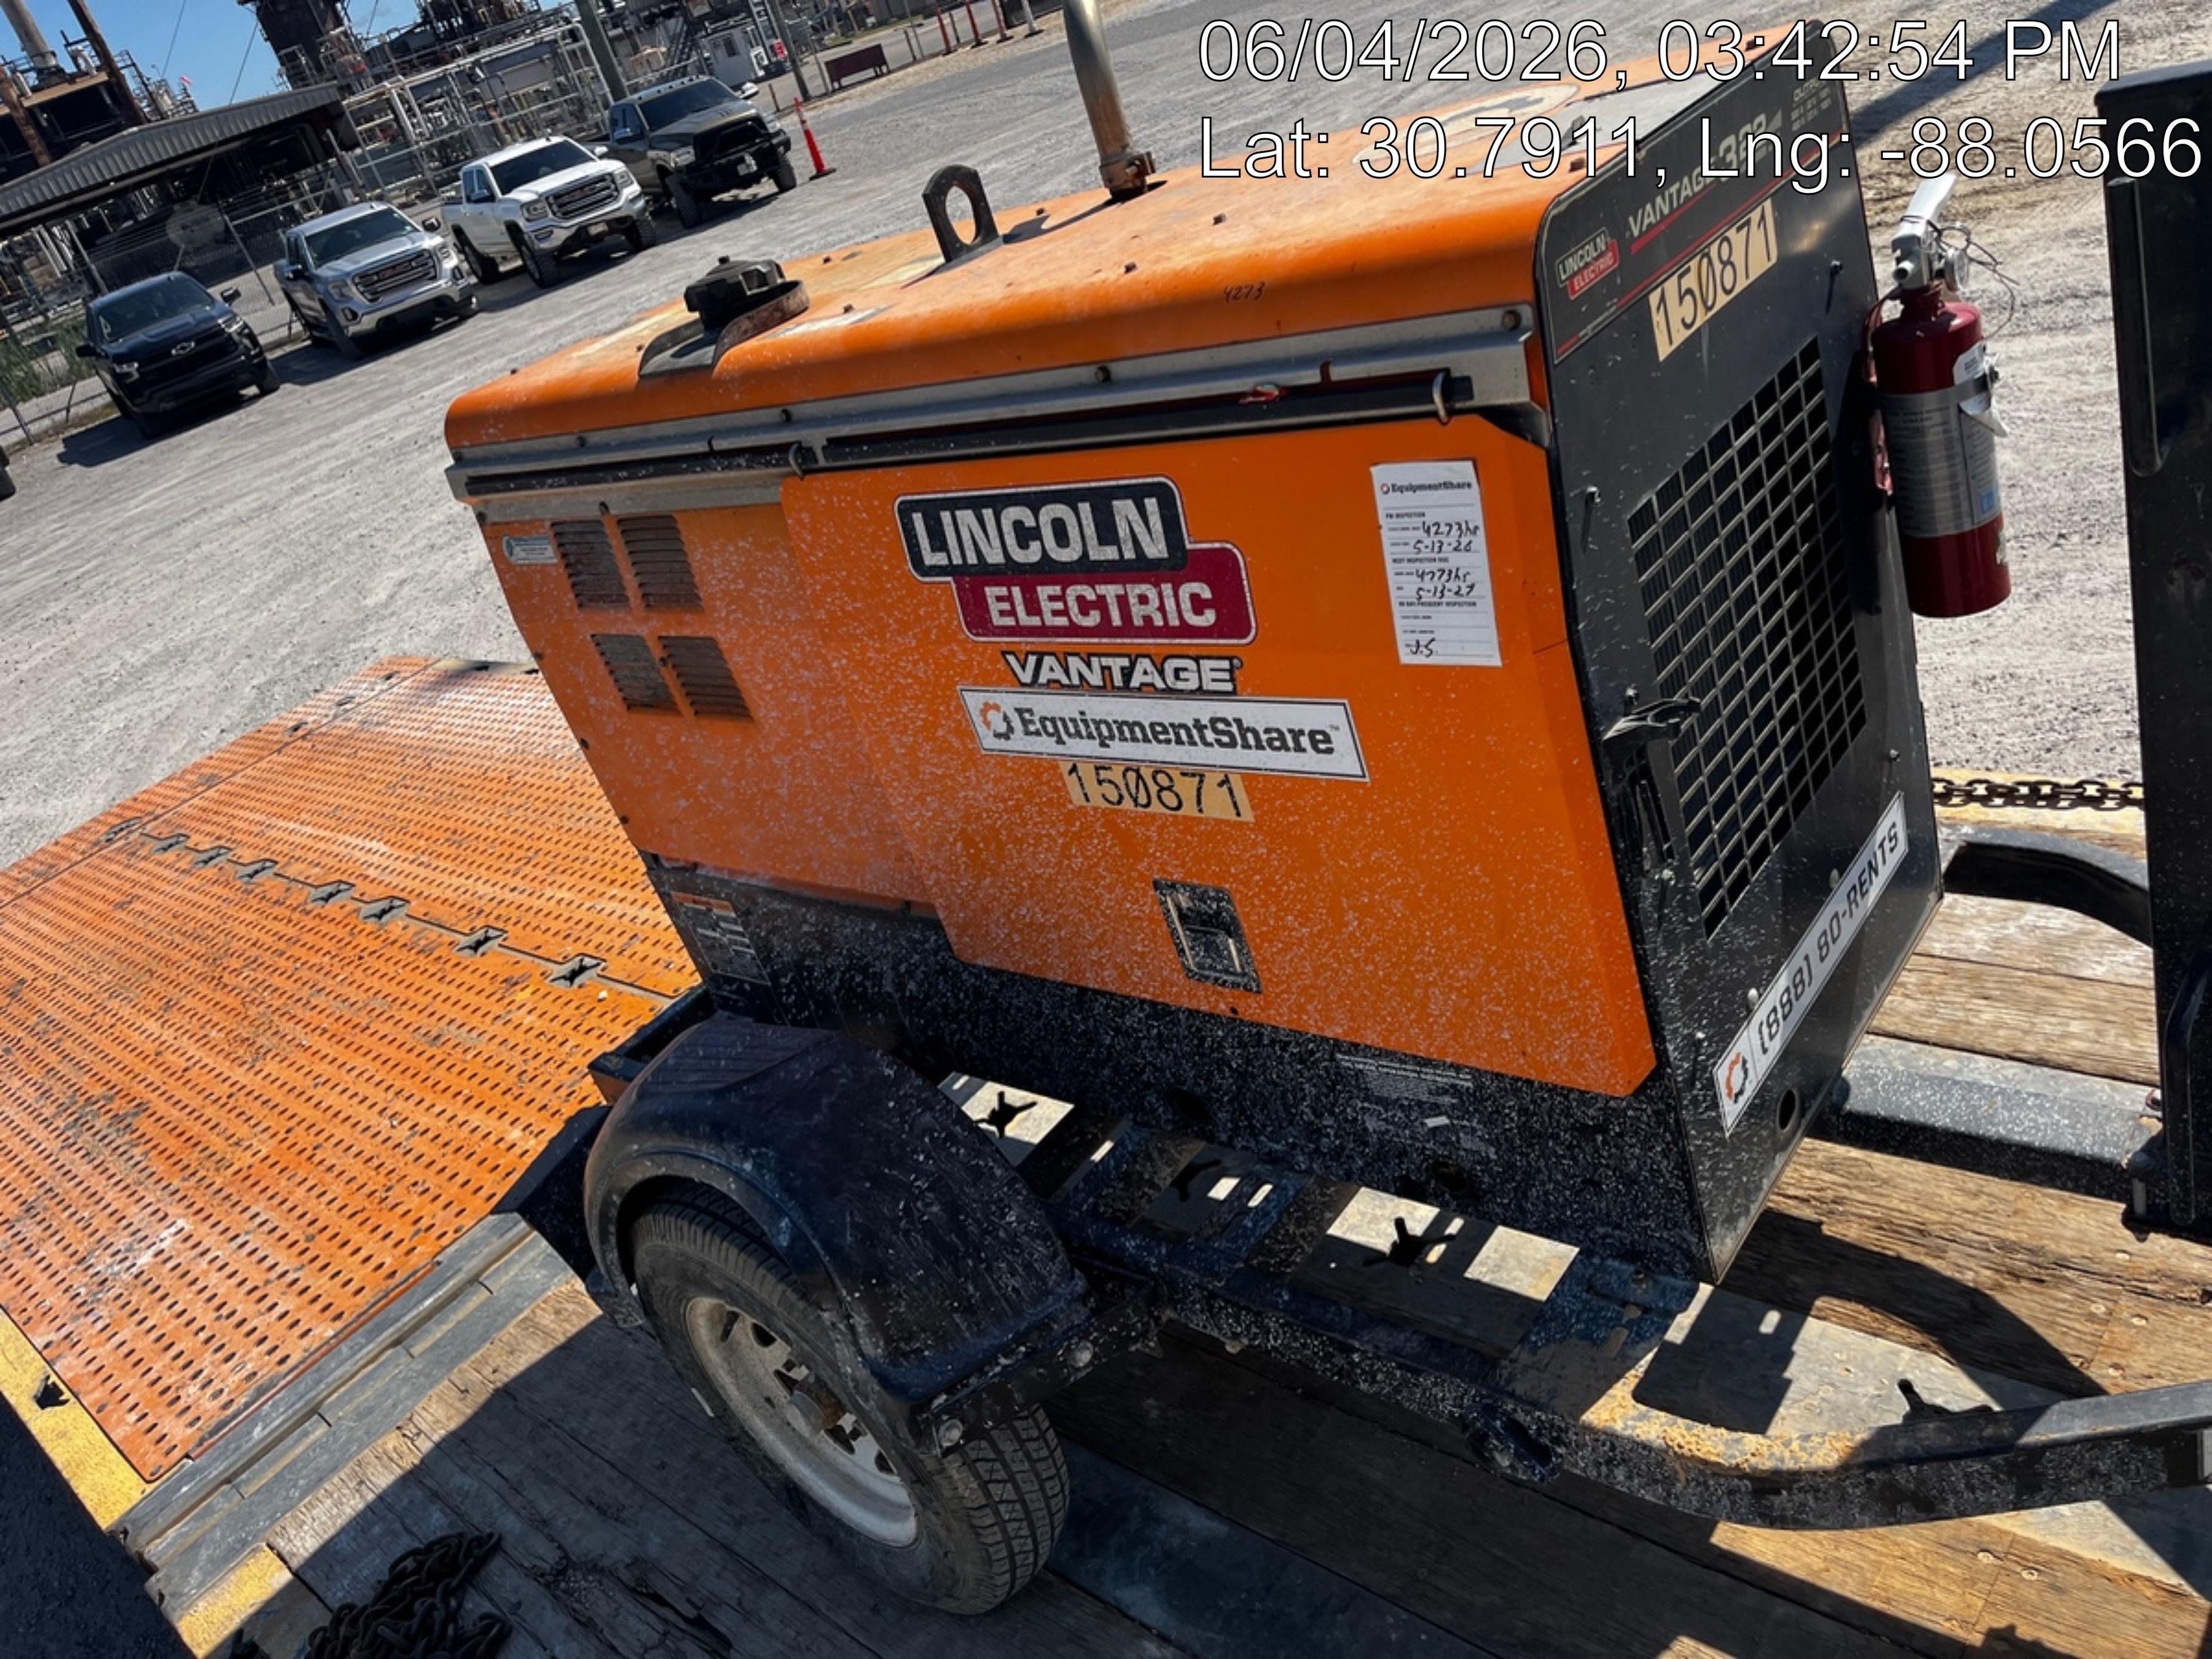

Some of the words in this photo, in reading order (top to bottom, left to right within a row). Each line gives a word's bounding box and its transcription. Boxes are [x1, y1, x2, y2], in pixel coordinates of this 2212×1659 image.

[1558, 233, 1606, 281] LINCOLN
[1574, 251, 1614, 290] ELECTRIC
[1656, 211, 1773, 347] 150871
[1223, 281, 1266, 304] 4273
[1391, 480, 1472, 494] EquipmentShare
[911, 496, 1169, 567] LINCOLN
[986, 582, 1217, 628] ELECTRIC
[1068, 763, 1242, 818] 150871
[1818, 822, 1899, 965] 80-RENTS
